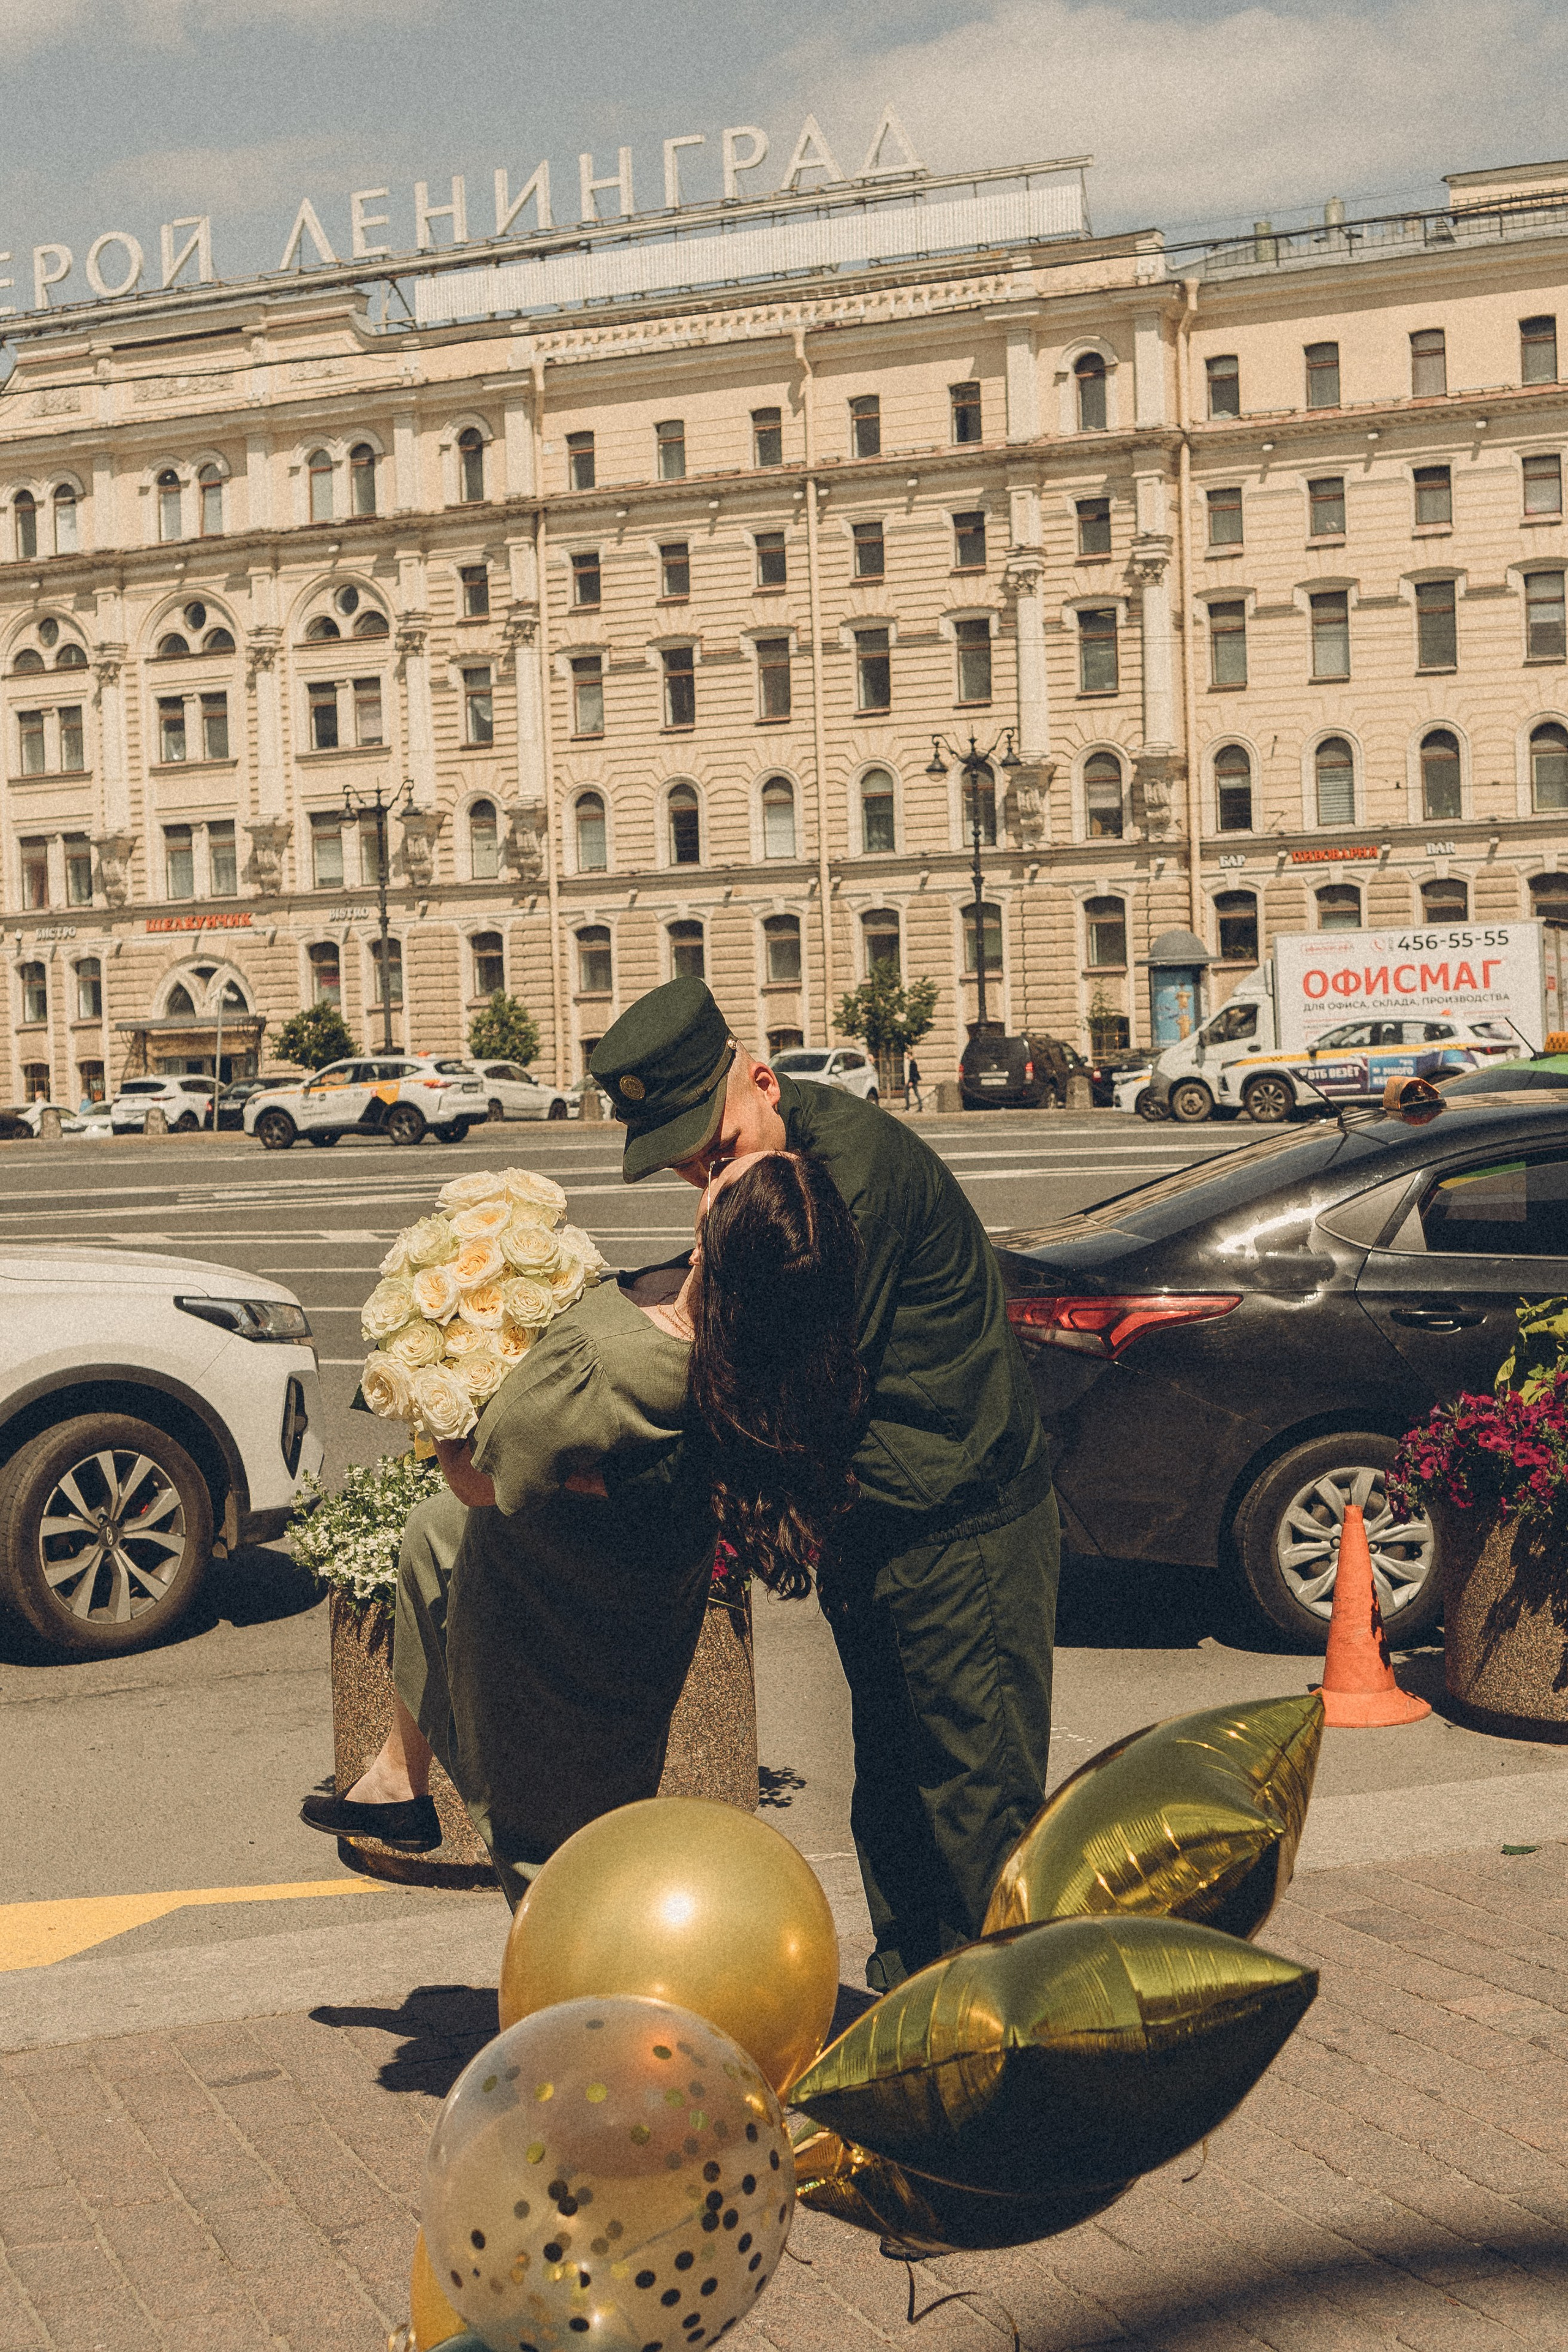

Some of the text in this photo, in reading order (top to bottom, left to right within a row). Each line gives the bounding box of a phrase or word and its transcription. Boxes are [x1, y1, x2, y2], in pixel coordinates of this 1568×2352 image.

[280, 103, 932, 271] ЛЕНИНГРАД
[1292, 846, 1378, 863] ПИВОВАРНЯ
[1426, 842, 1455, 856] BAR
[1219, 854, 1245, 868] БАР
[330, 907, 369, 921] BISTRO
[36, 925, 77, 941] БИСТРО
[1398, 930, 1509, 950] 456-55-55
[1303, 959, 1502, 999] ОФИСМАГ
[1303, 993, 1510, 1012] ДЛЯ ОФИСА, СКЛАДА, ПРОИЗВОДСТВА
